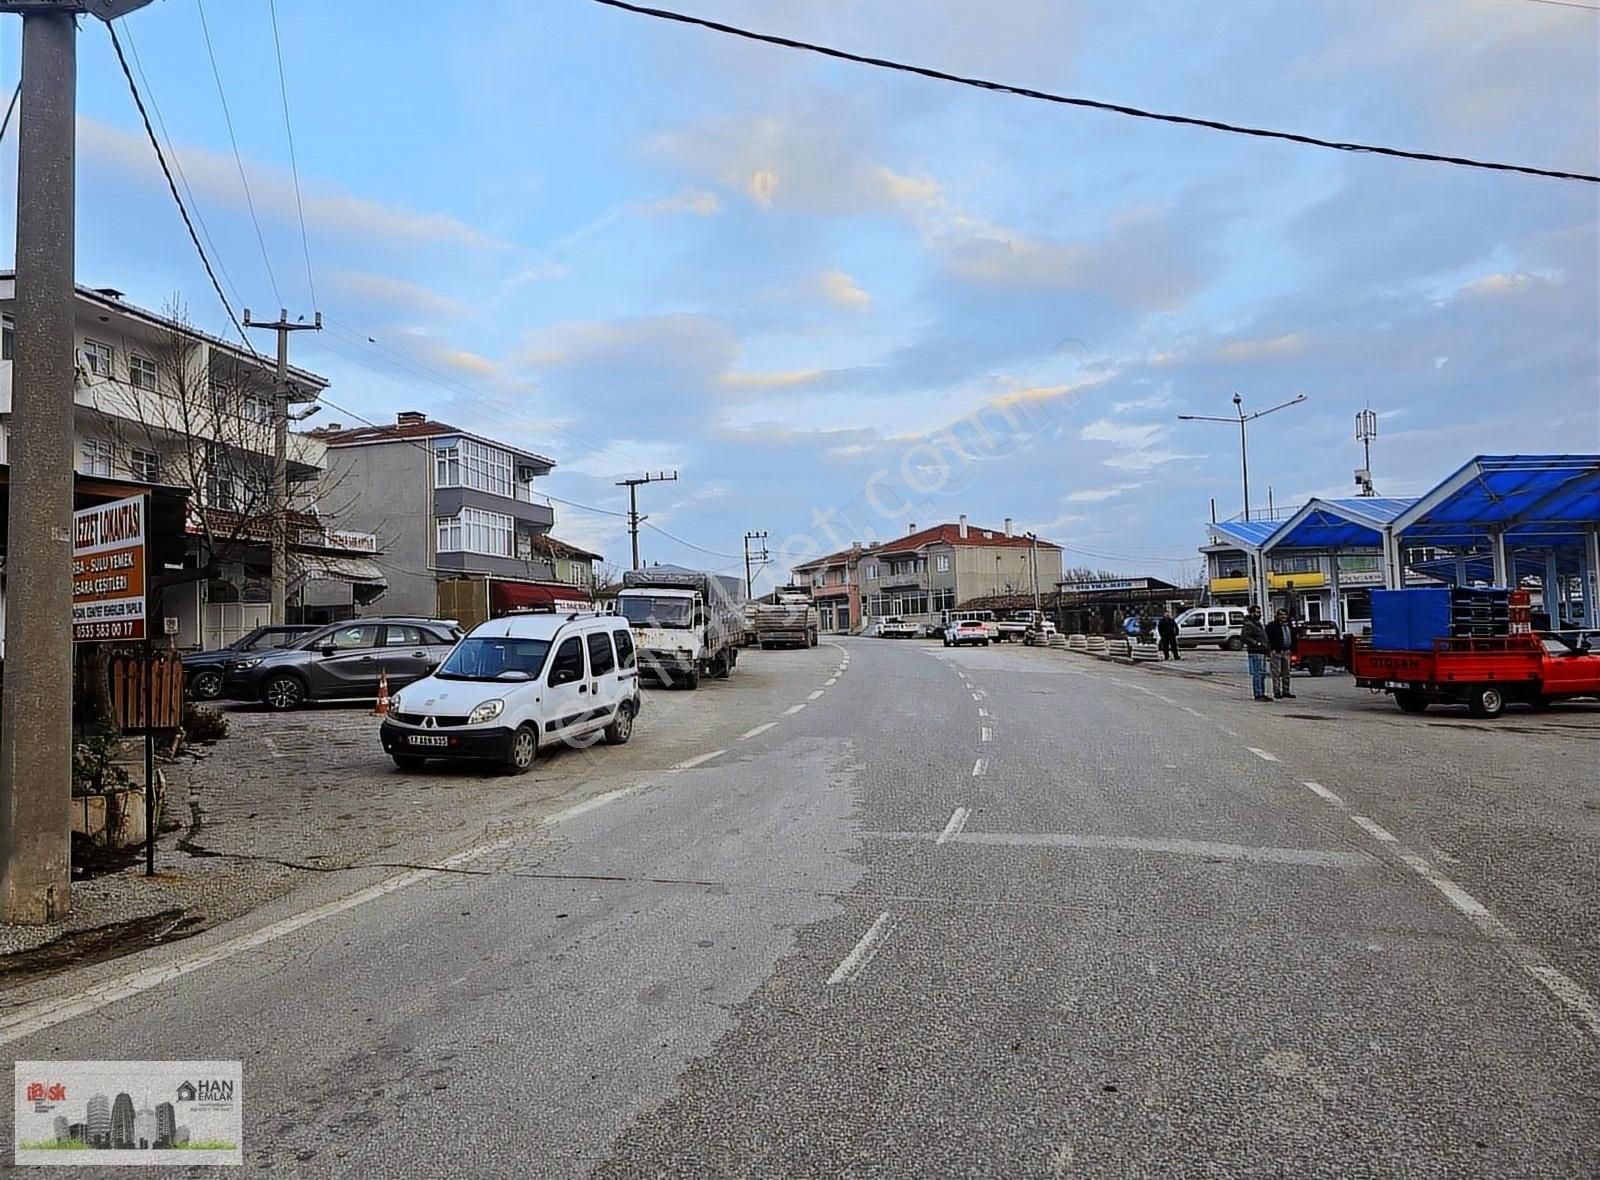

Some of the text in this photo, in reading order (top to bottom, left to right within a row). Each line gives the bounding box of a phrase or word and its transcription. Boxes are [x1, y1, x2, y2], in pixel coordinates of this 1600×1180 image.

[101, 503, 140, 544] LOKANTASI
[110, 552, 134, 569] YEMEK
[77, 625, 94, 638] 0535
[112, 622, 122, 636] 00
[124, 621, 133, 636] 17
